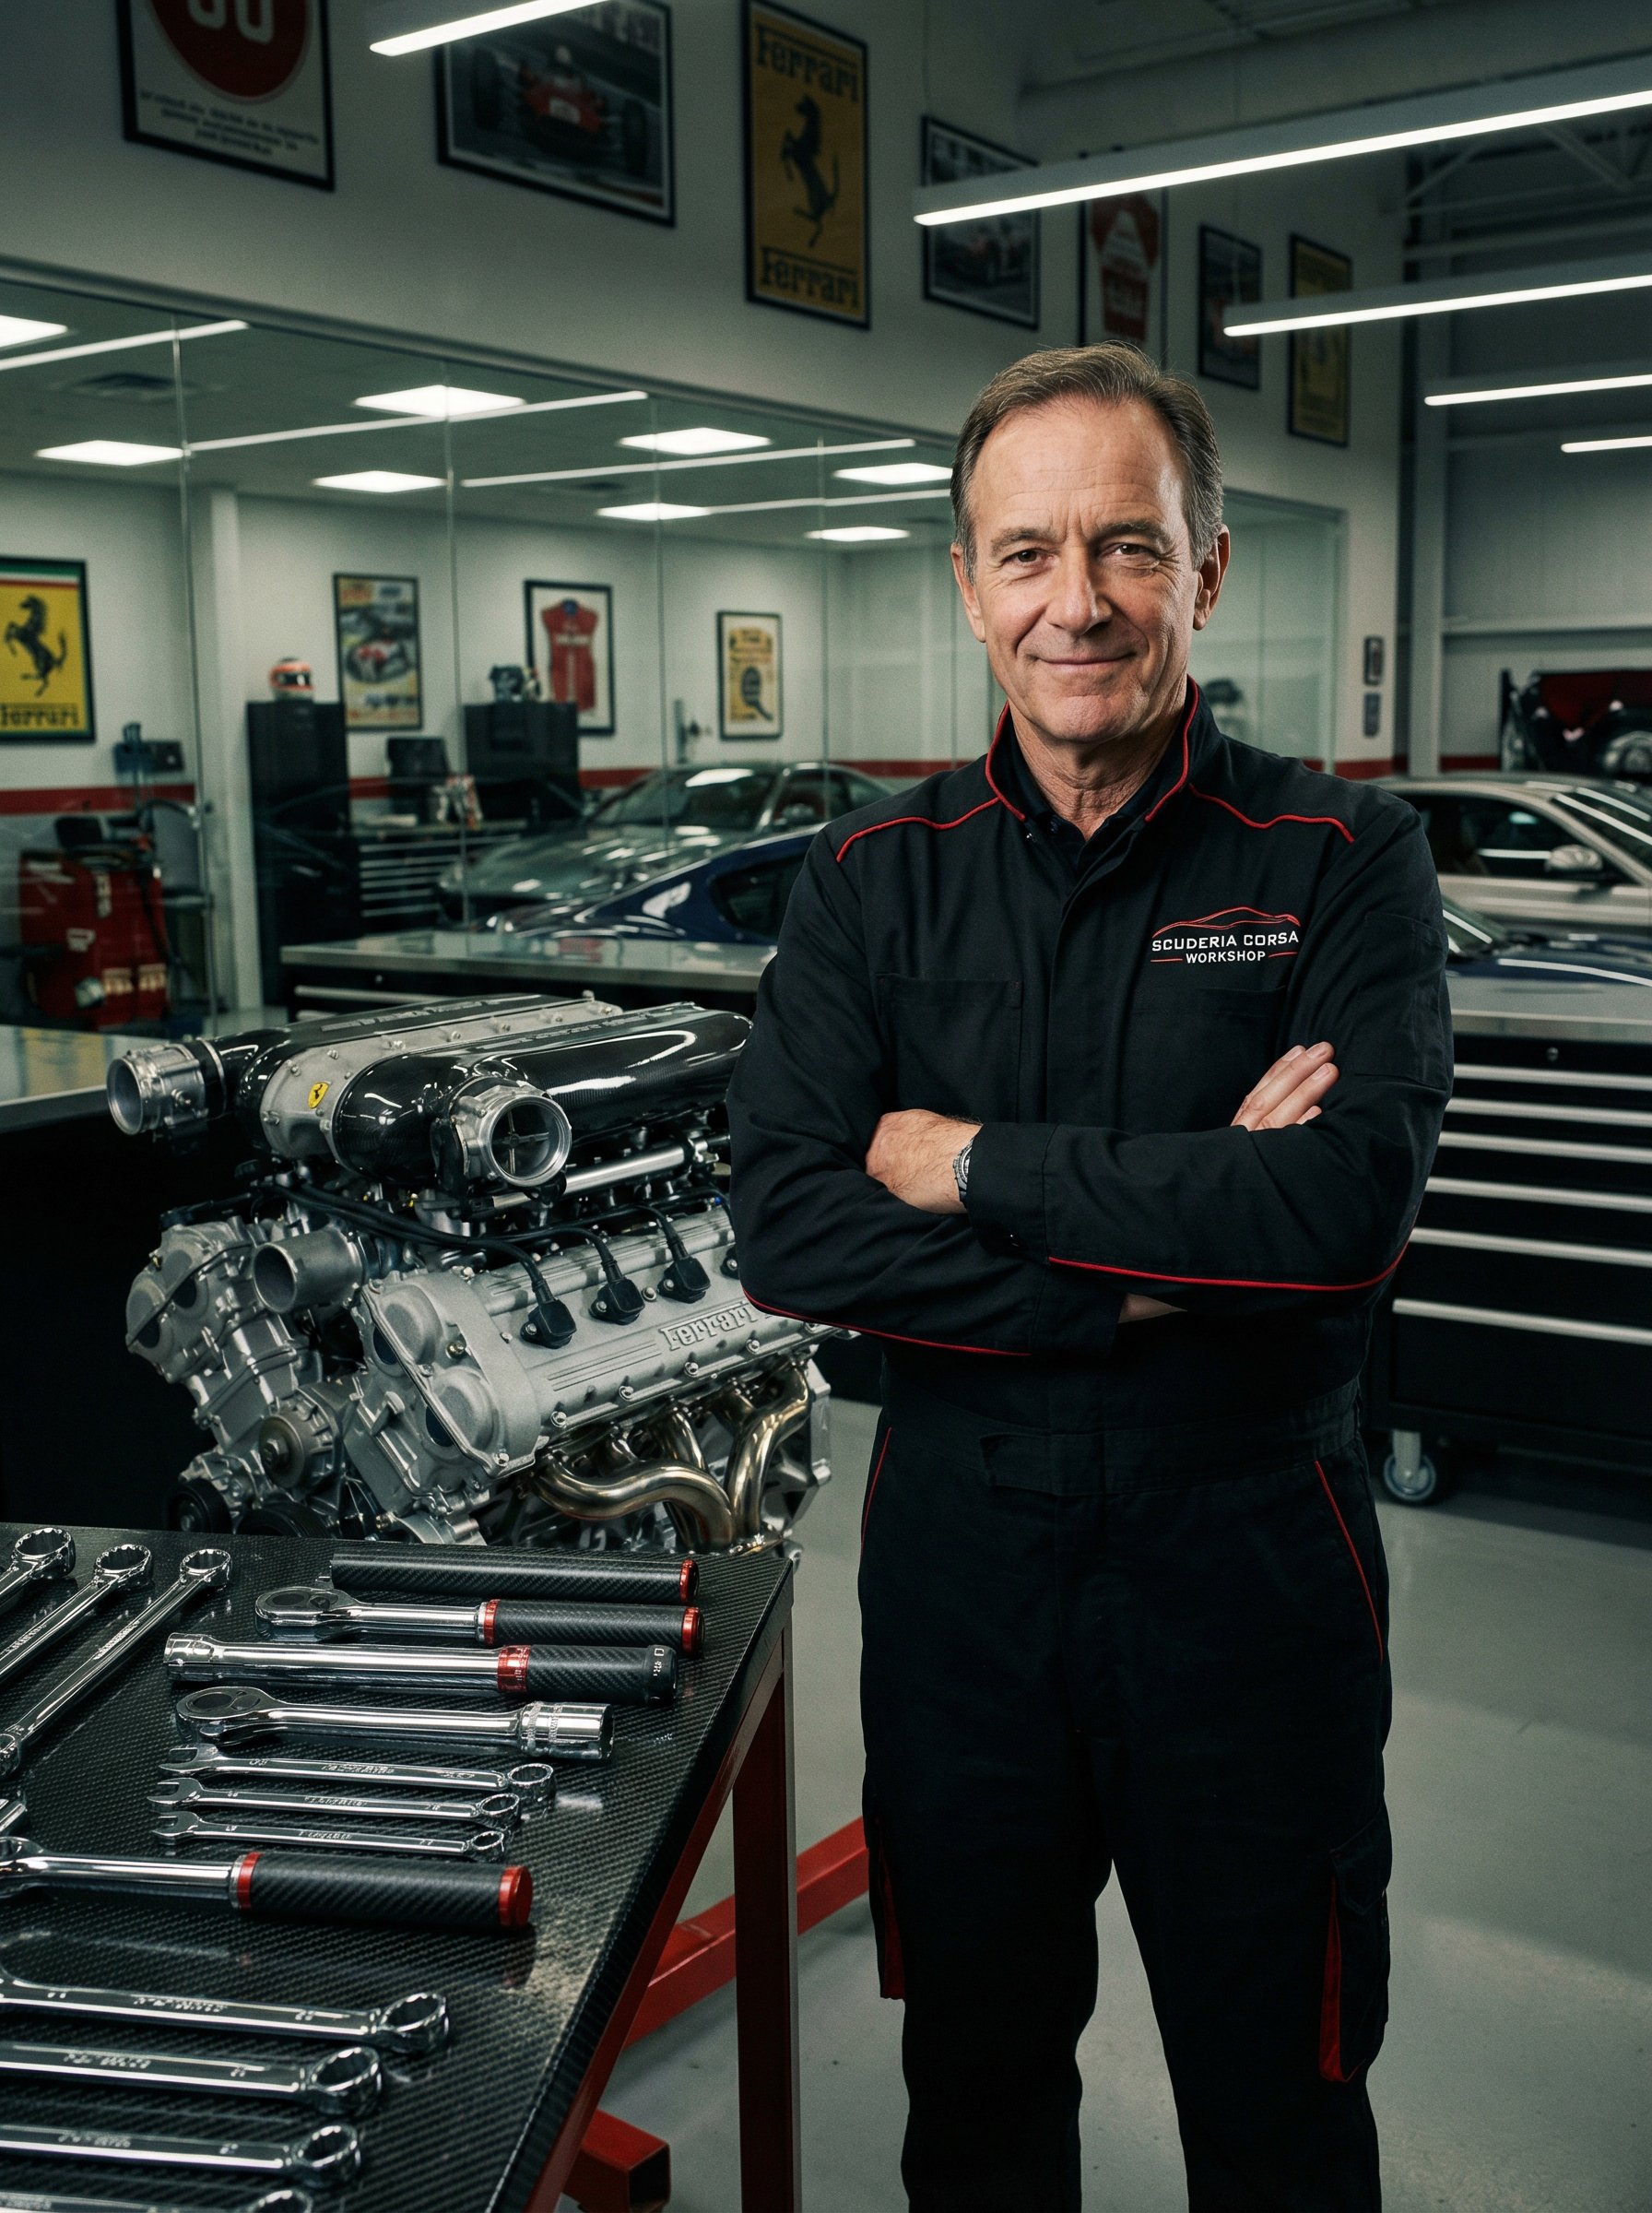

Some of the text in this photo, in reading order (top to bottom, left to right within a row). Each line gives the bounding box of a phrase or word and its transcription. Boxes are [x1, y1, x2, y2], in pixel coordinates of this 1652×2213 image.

[756, 24, 858, 103] Ferrari
[760, 246, 859, 309] Ferrari
[1151, 930, 1299, 952] SCUDERIA CORSA
[1186, 951, 1266, 964] WORKSHOP
[659, 1300, 757, 1351] Ferrari
